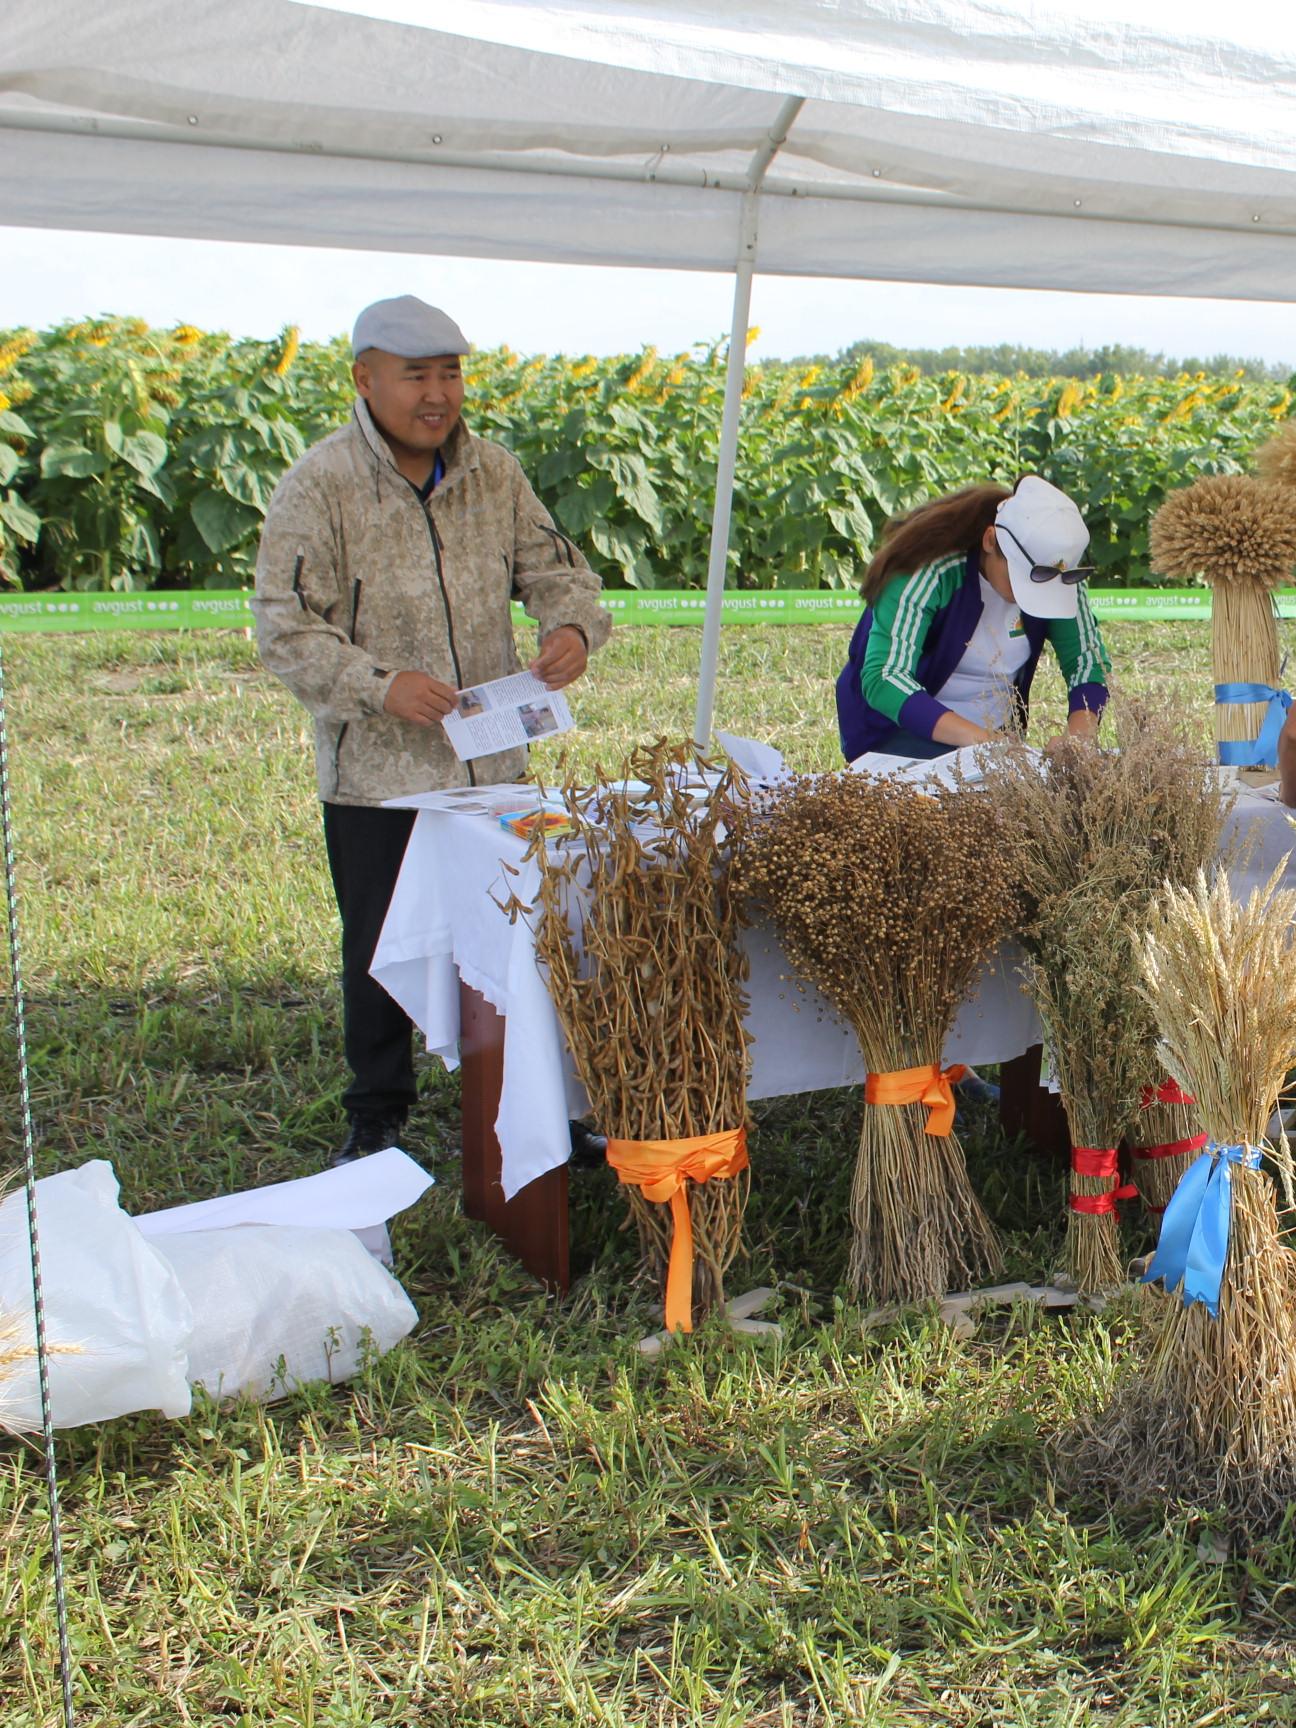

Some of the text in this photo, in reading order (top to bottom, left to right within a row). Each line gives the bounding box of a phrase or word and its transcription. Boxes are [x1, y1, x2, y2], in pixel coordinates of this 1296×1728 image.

[94, 600, 142, 616] avgust
[192, 598, 240, 614] avgust
[638, 597, 677, 612] avgust
[795, 597, 833, 612] avgust
[1088, 596, 1114, 608] vgust
[1146, 595, 1178, 608] avgust
[0, 601, 41, 618] vgust
